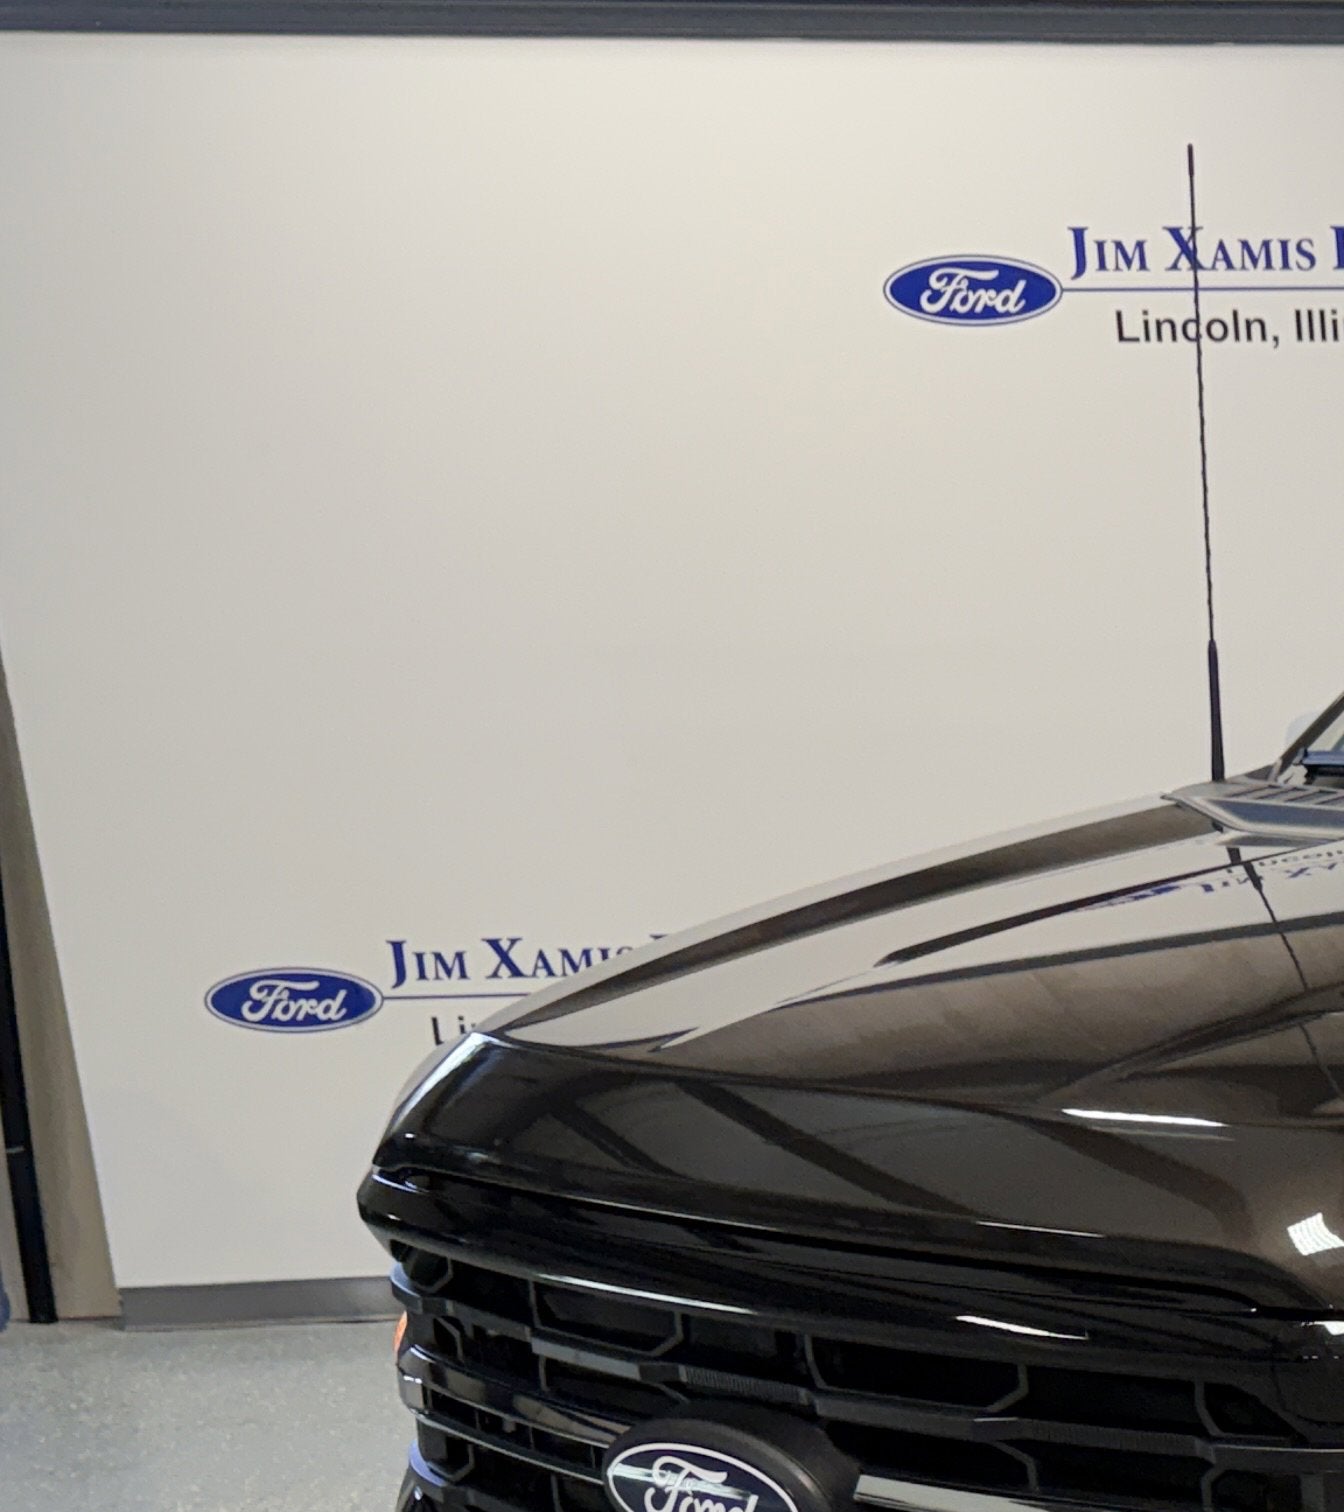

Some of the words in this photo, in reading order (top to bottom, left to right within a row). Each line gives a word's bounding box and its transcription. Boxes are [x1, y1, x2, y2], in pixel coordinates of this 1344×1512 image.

[1066, 226, 1149, 280] JIM
[1162, 226, 1317, 273] XAMIS
[919, 266, 1027, 315] Ford
[1116, 310, 1280, 348] Lincoln,
[386, 939, 470, 990] JIM
[241, 979, 348, 1023] Ford
